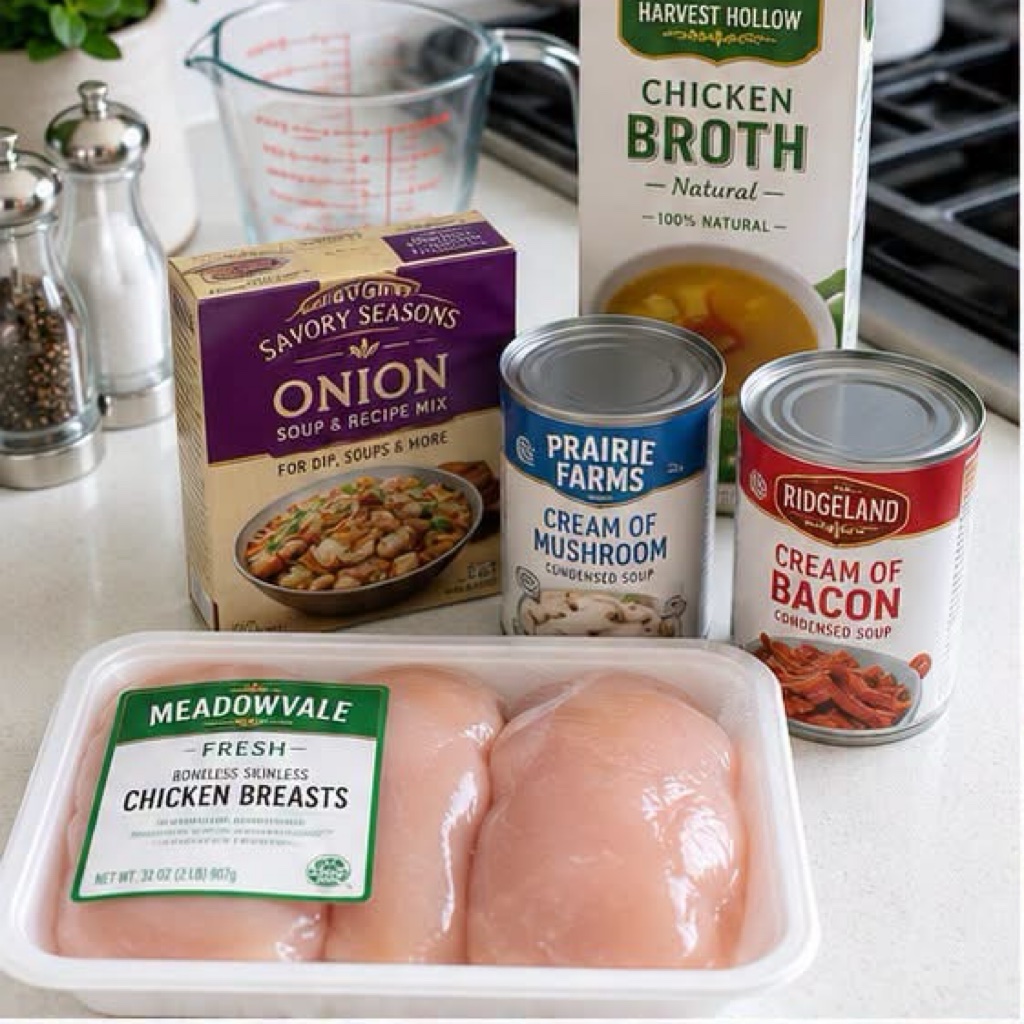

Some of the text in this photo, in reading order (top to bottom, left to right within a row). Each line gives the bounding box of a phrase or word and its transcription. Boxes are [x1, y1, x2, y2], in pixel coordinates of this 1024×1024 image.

[637, 1, 802, 30] HARVEST HOLLOW
[641, 79, 793, 114] CHICKEN
[627, 113, 808, 173] BROTH
[671, 176, 759, 201] Natural
[657, 211, 770, 233] 100% NATURAL
[258, 302, 461, 363] SAVORY SEASONS
[273, 353, 449, 419] ONION
[276, 396, 448, 443] SOUP & RECIPE MIX
[277, 458, 306, 477] FOR
[311, 453, 341, 472] DIP,
[343, 444, 390, 466] SOUPS
[408, 430, 449, 451] MORE
[546, 433, 656, 466] PRAIRIE
[556, 461, 645, 492] FARMS
[783, 483, 900, 523] RIDGELAND
[543, 507, 658, 538] CREAM OF
[534, 528, 667, 566] MUSHROOM
[775, 543, 903, 584] CREAM OF
[545, 562, 655, 585] CONDENSED SOUP
[771, 568, 902, 621] BACON
[773, 609, 892, 640] CONDENSED SOUP
[150, 694, 353, 727] MEADOWVALE
[202, 741, 286, 757] FRESH
[172, 767, 309, 782] BONELESS SKINLESS
[123, 784, 350, 811] CHICKEN BREASTS
[94, 871, 117, 884] NET
